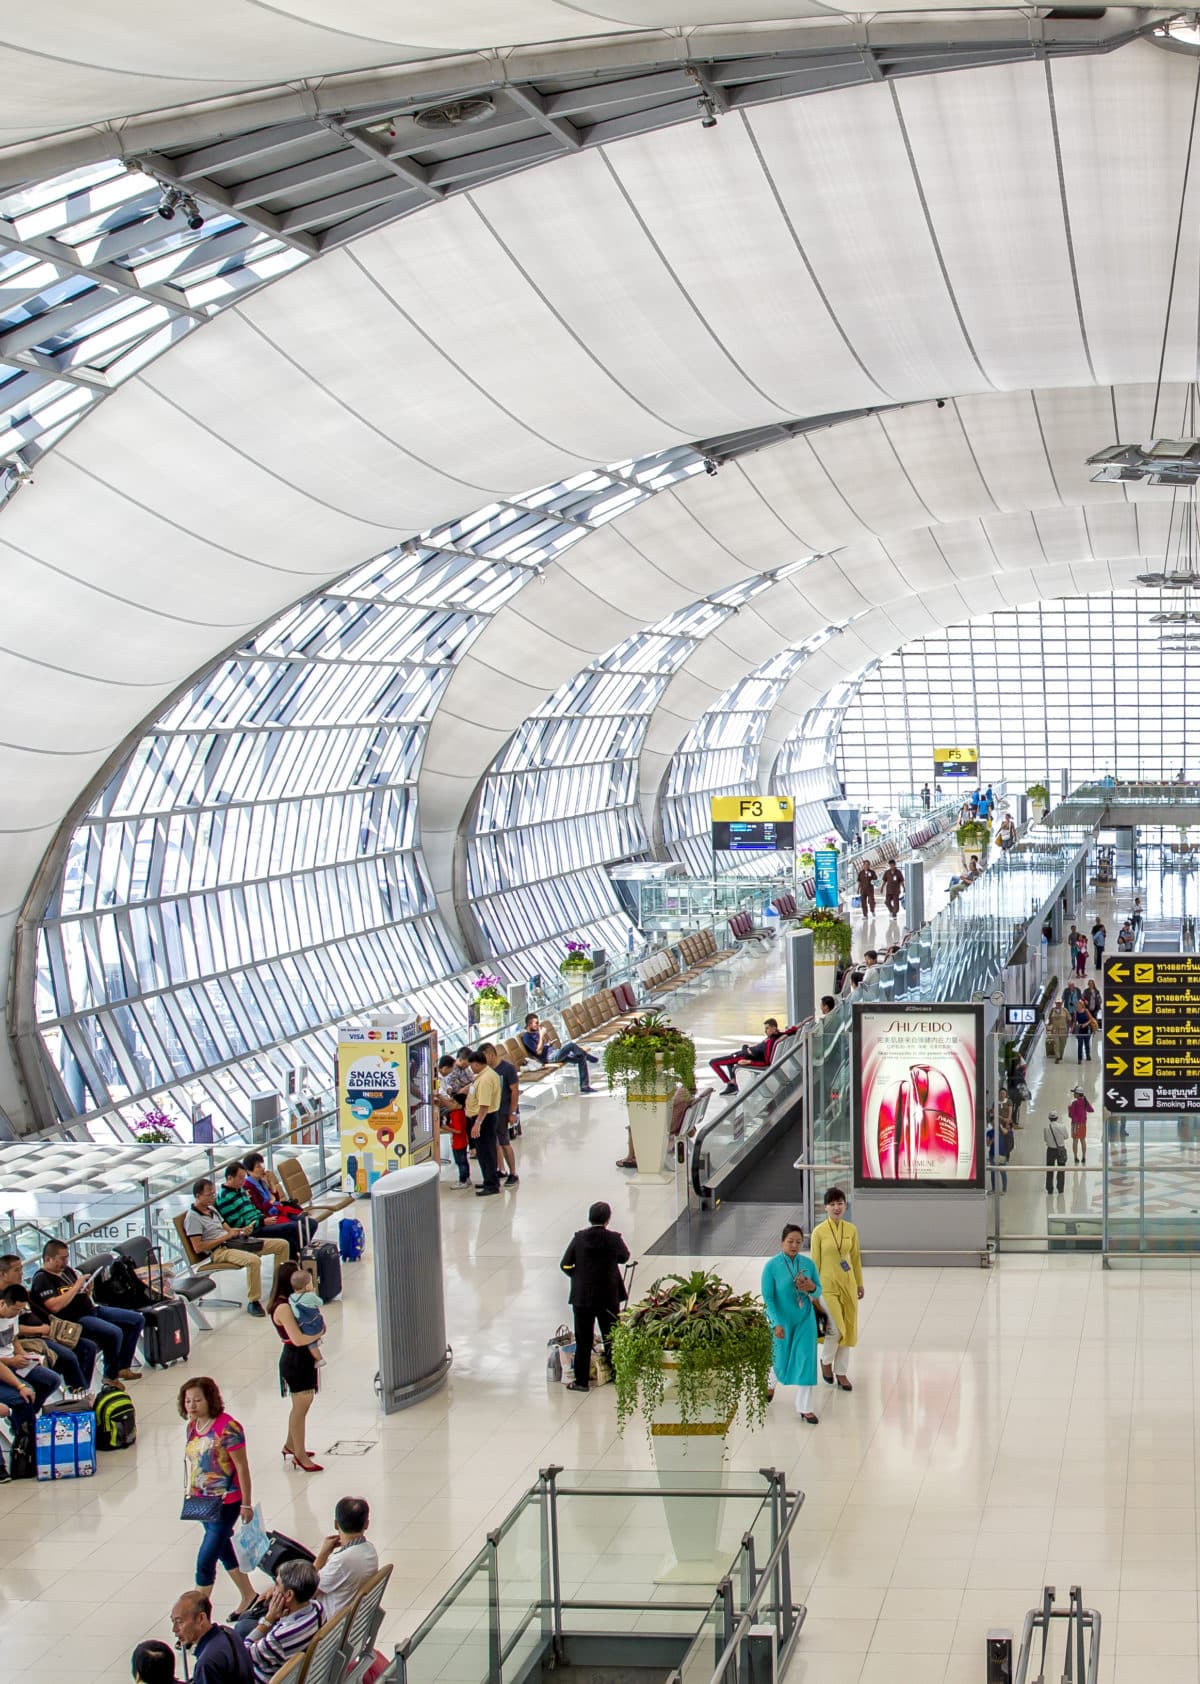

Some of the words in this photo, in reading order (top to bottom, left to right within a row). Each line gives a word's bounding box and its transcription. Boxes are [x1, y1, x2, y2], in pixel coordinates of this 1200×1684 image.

[948, 750, 962, 760] F5
[739, 800, 763, 817] F3
[883, 1020, 953, 1033] SHISEIDO
[1156, 1038, 1176, 1046] Gates
[350, 1071, 395, 1080] SNACKS
[1155, 1069, 1176, 1077] Gates
[348, 1079, 397, 1088] &DRINKS
[1156, 1101, 1186, 1109] Smoking
